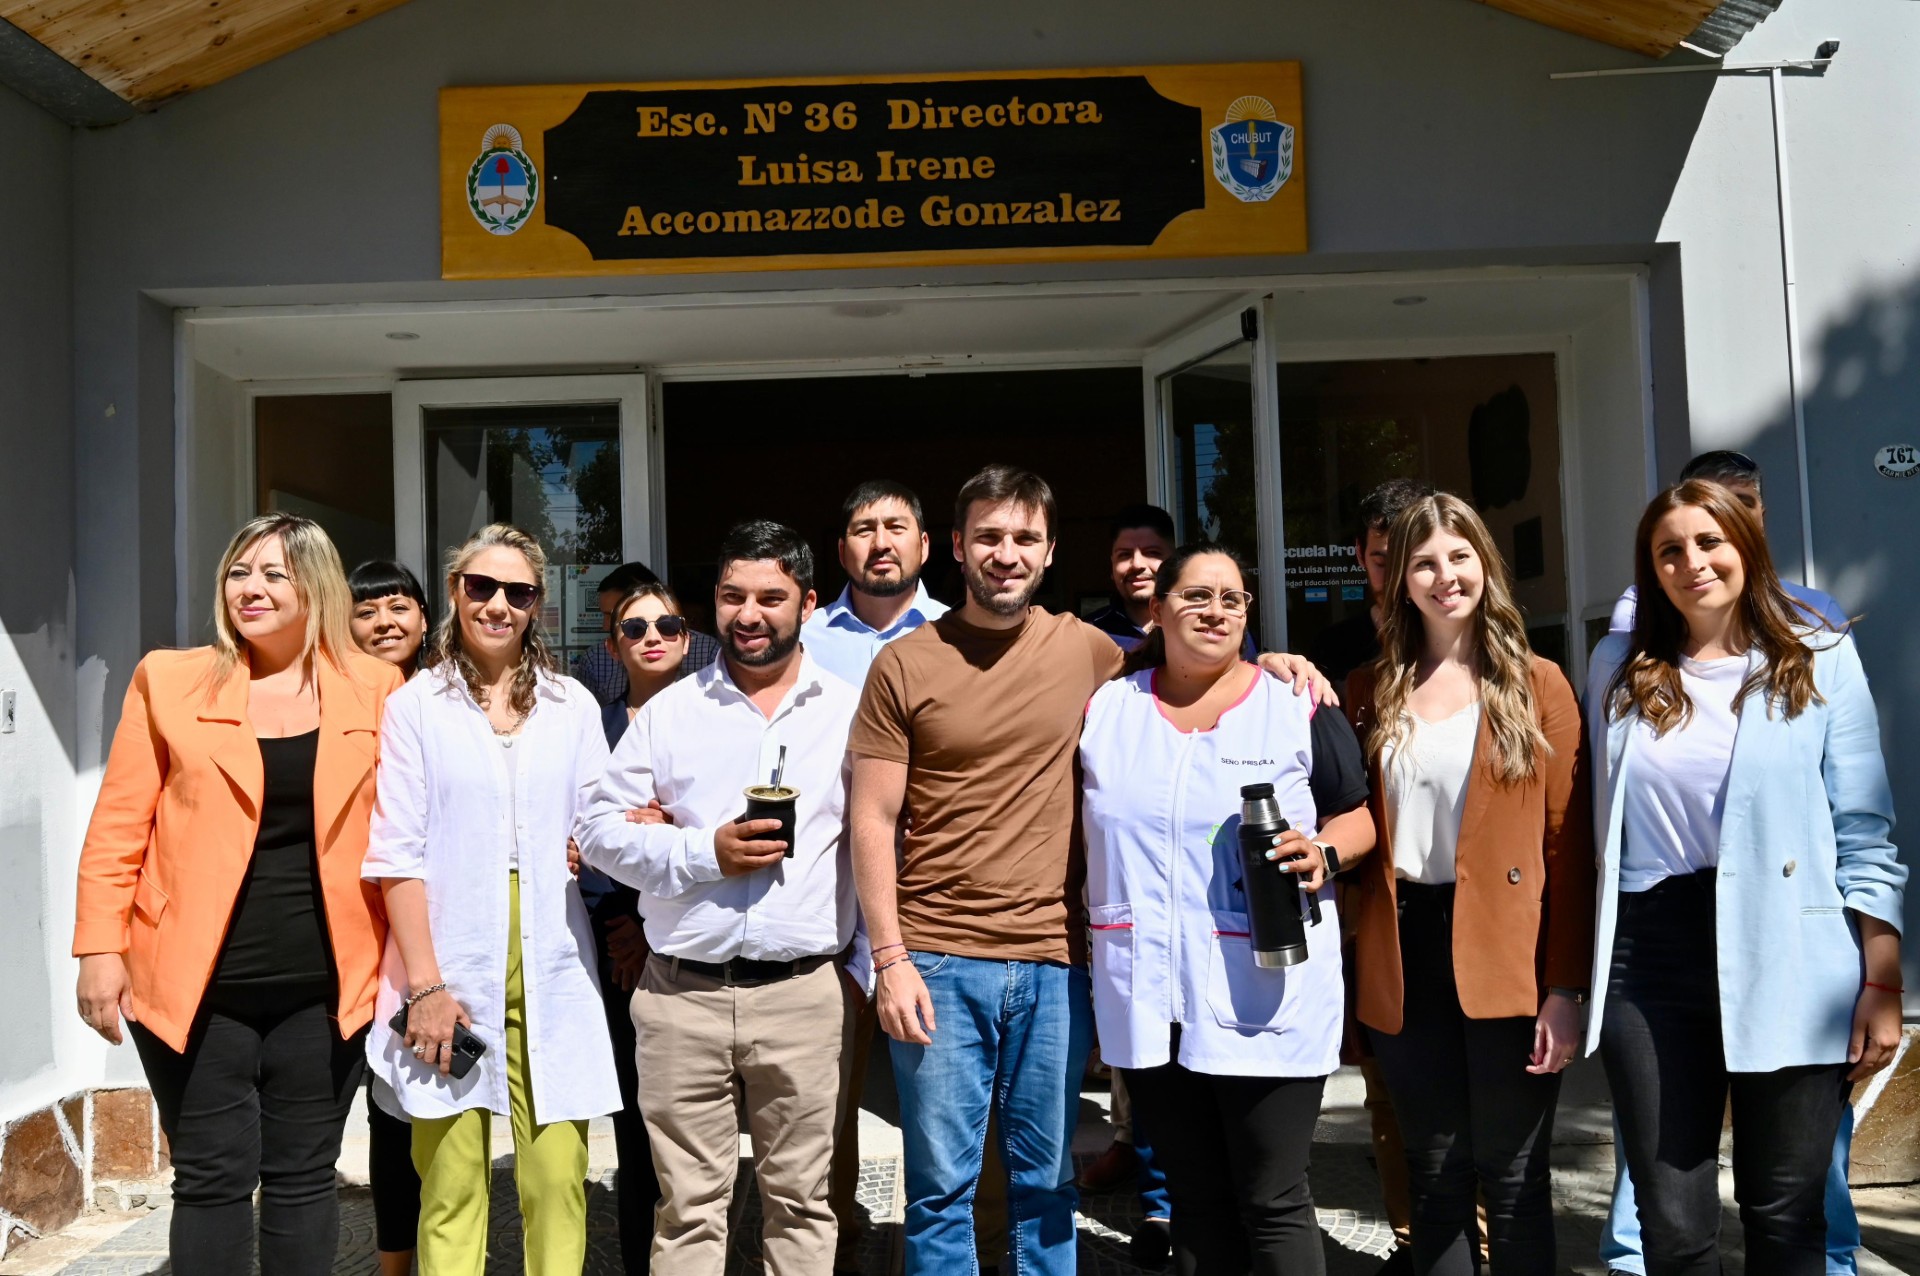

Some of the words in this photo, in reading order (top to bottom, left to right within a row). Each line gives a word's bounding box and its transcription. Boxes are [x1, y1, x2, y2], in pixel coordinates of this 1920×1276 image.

[636, 106, 728, 137] Esc.
[804, 101, 858, 133] 36
[886, 96, 1103, 130] Directora
[1230, 132, 1272, 144] CHUBUT
[737, 153, 864, 186] Luisa
[876, 151, 996, 182] Irene
[920, 192, 1121, 227] Gonzalez
[1887, 448, 1915, 464] 767
[1298, 565, 1323, 574] Luisa
[1324, 564, 1349, 573] Irene
[1304, 578, 1340, 587] Educación
[1341, 577, 1368, 585] Intercul
